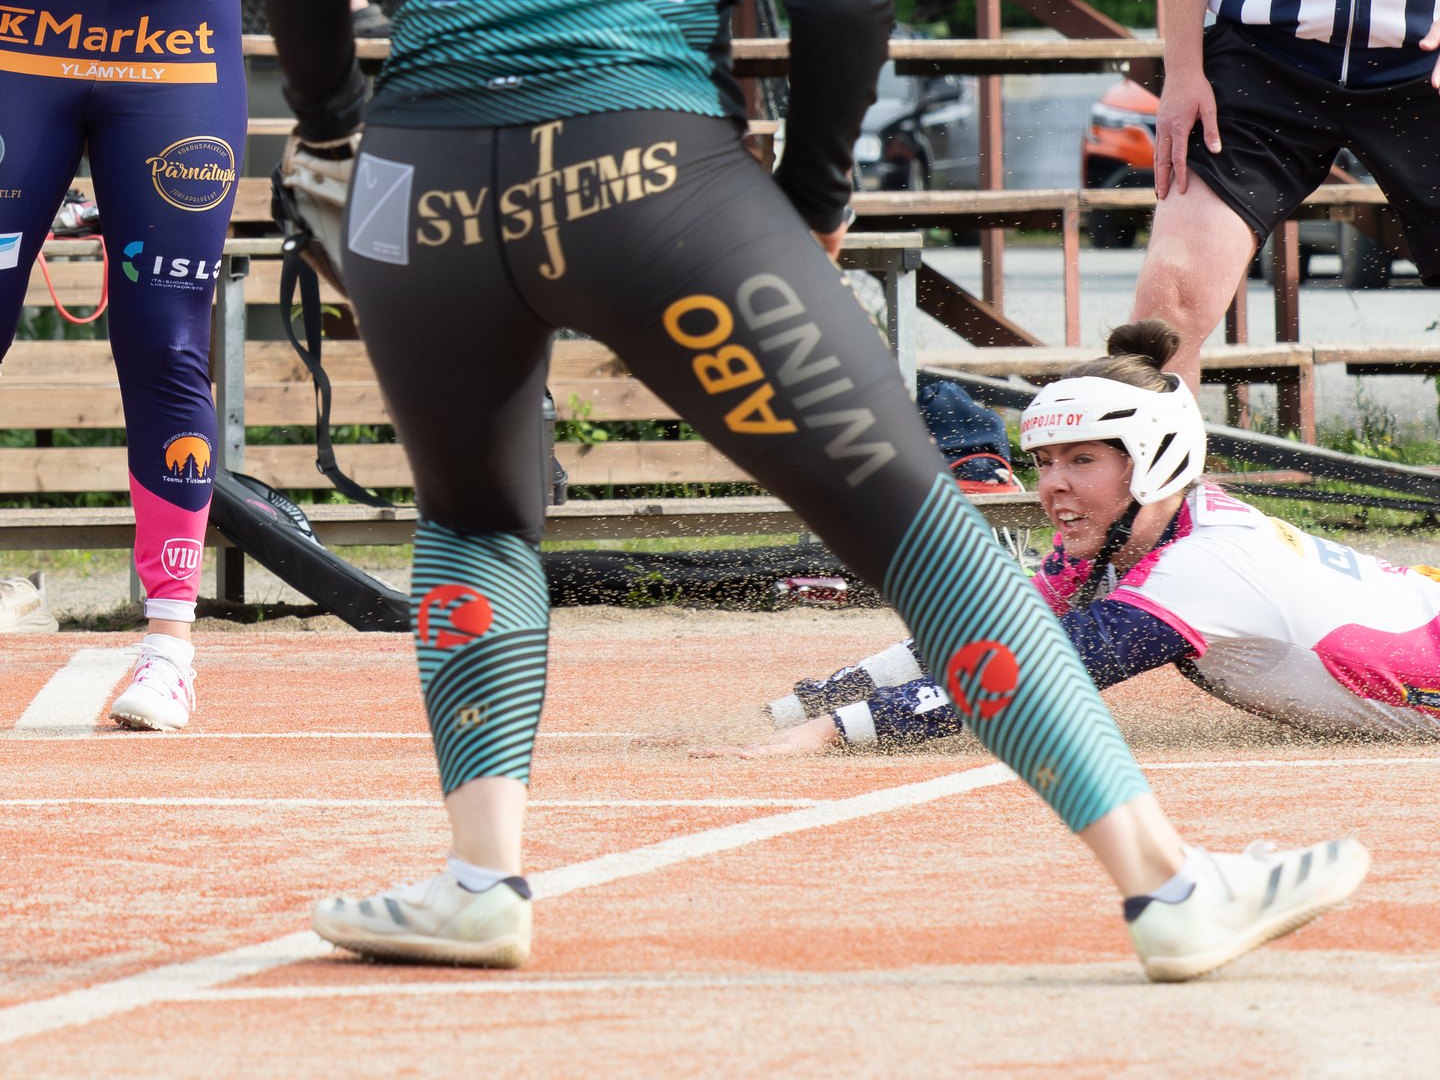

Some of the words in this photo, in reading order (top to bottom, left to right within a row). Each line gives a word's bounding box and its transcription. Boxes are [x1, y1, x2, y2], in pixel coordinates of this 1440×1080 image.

[60, 62, 166, 80] YLÄMYLLY
[145, 156, 236, 188] Pärnätupa
[664, 294, 798, 435] ABO
[737, 273, 898, 488] WIND
[1066, 413, 1083, 426] OY
[167, 548, 199, 569] VIU
